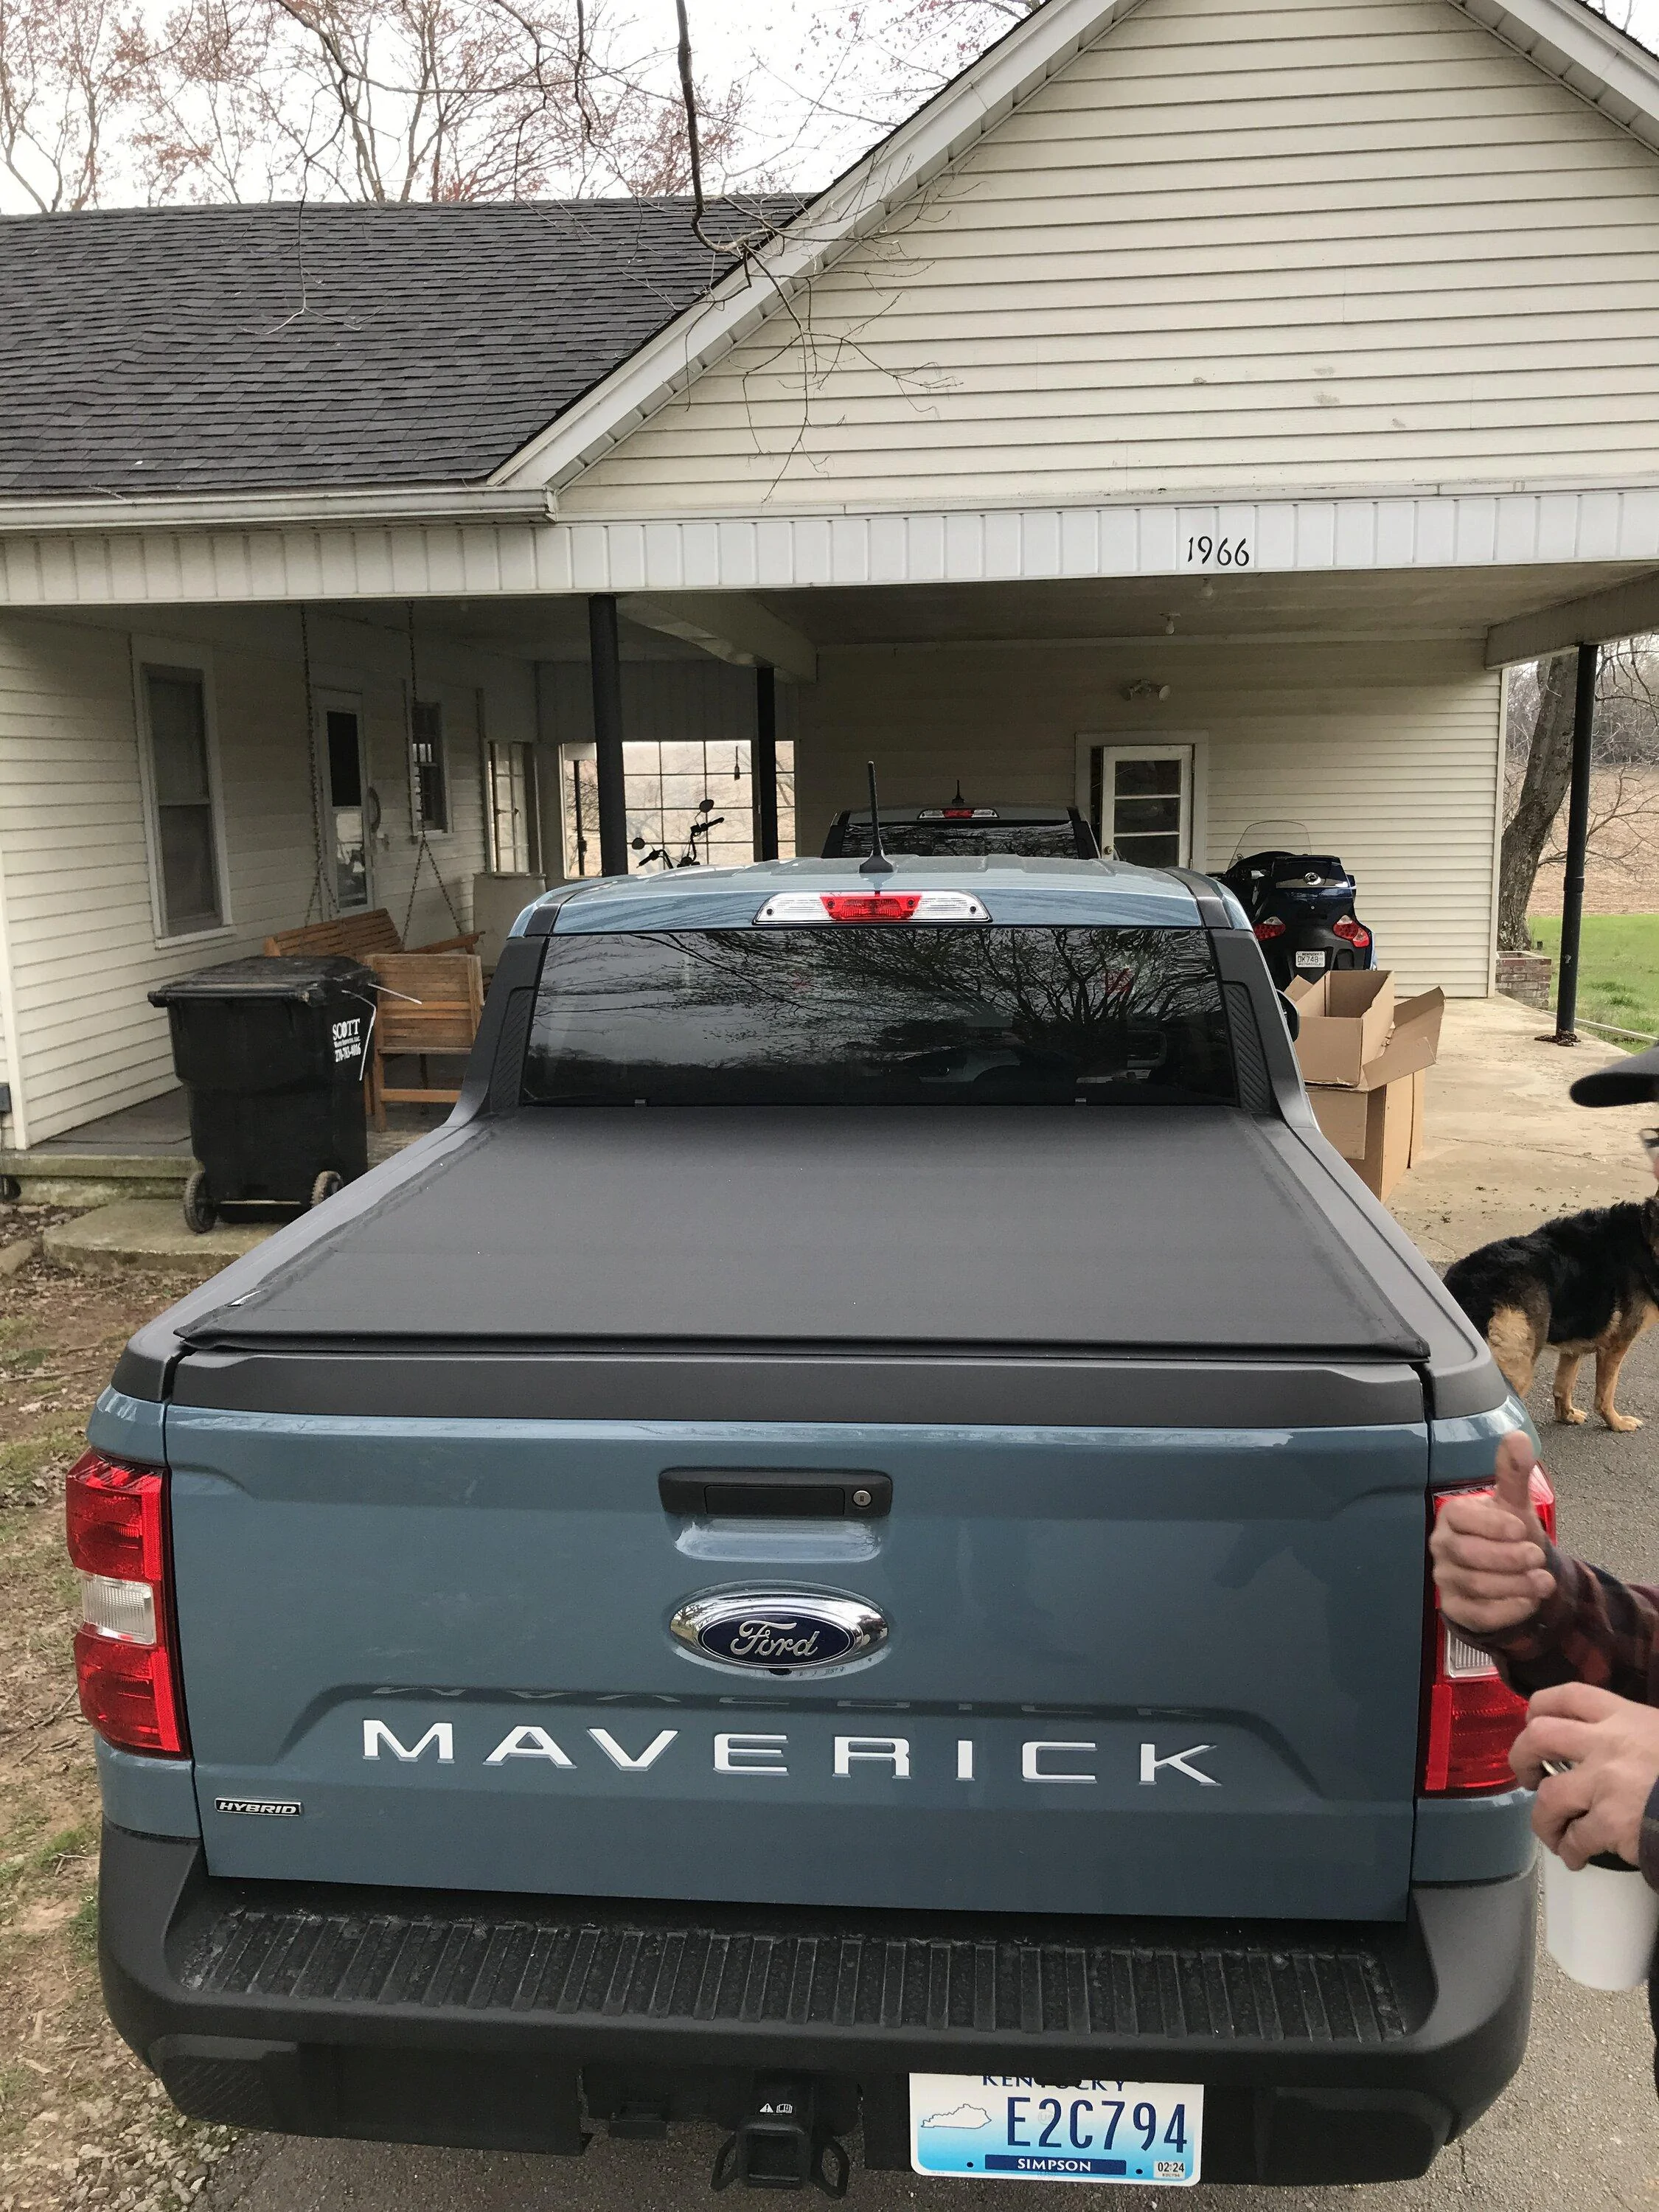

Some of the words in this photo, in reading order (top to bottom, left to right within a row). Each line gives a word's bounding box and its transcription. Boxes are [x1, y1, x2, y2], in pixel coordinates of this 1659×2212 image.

[1188, 536, 1249, 566] 1966
[333, 1018, 361, 1040] SCOTT
[730, 1620, 820, 1656] Ford
[363, 1719, 1218, 1784] MAVERICK
[219, 1802, 296, 1814] HYBRID
[982, 2075, 1124, 2092] KENKY
[1007, 2096, 1187, 2153] E2C794
[1017, 2158, 1091, 2172] SIMPSON
